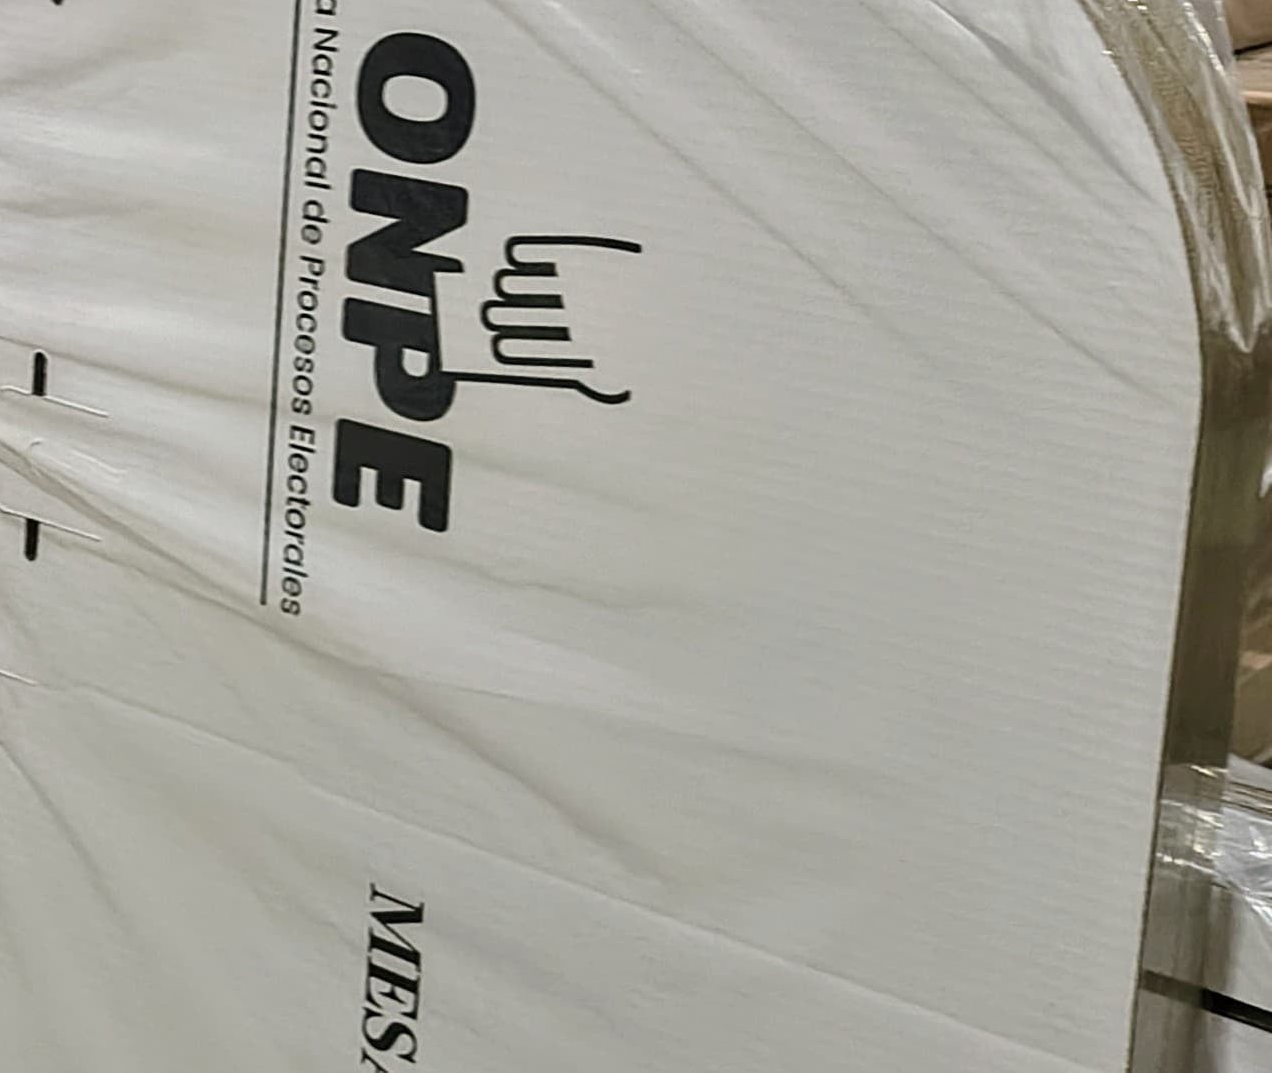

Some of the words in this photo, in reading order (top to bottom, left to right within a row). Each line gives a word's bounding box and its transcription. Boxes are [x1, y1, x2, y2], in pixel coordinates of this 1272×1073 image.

[303, 27, 340, 191] Nacional
[300, 199, 331, 246] de
[333, 31, 477, 533] ONPE
[291, 255, 326, 416] Procesos
[280, 424, 317, 616] Electorales
